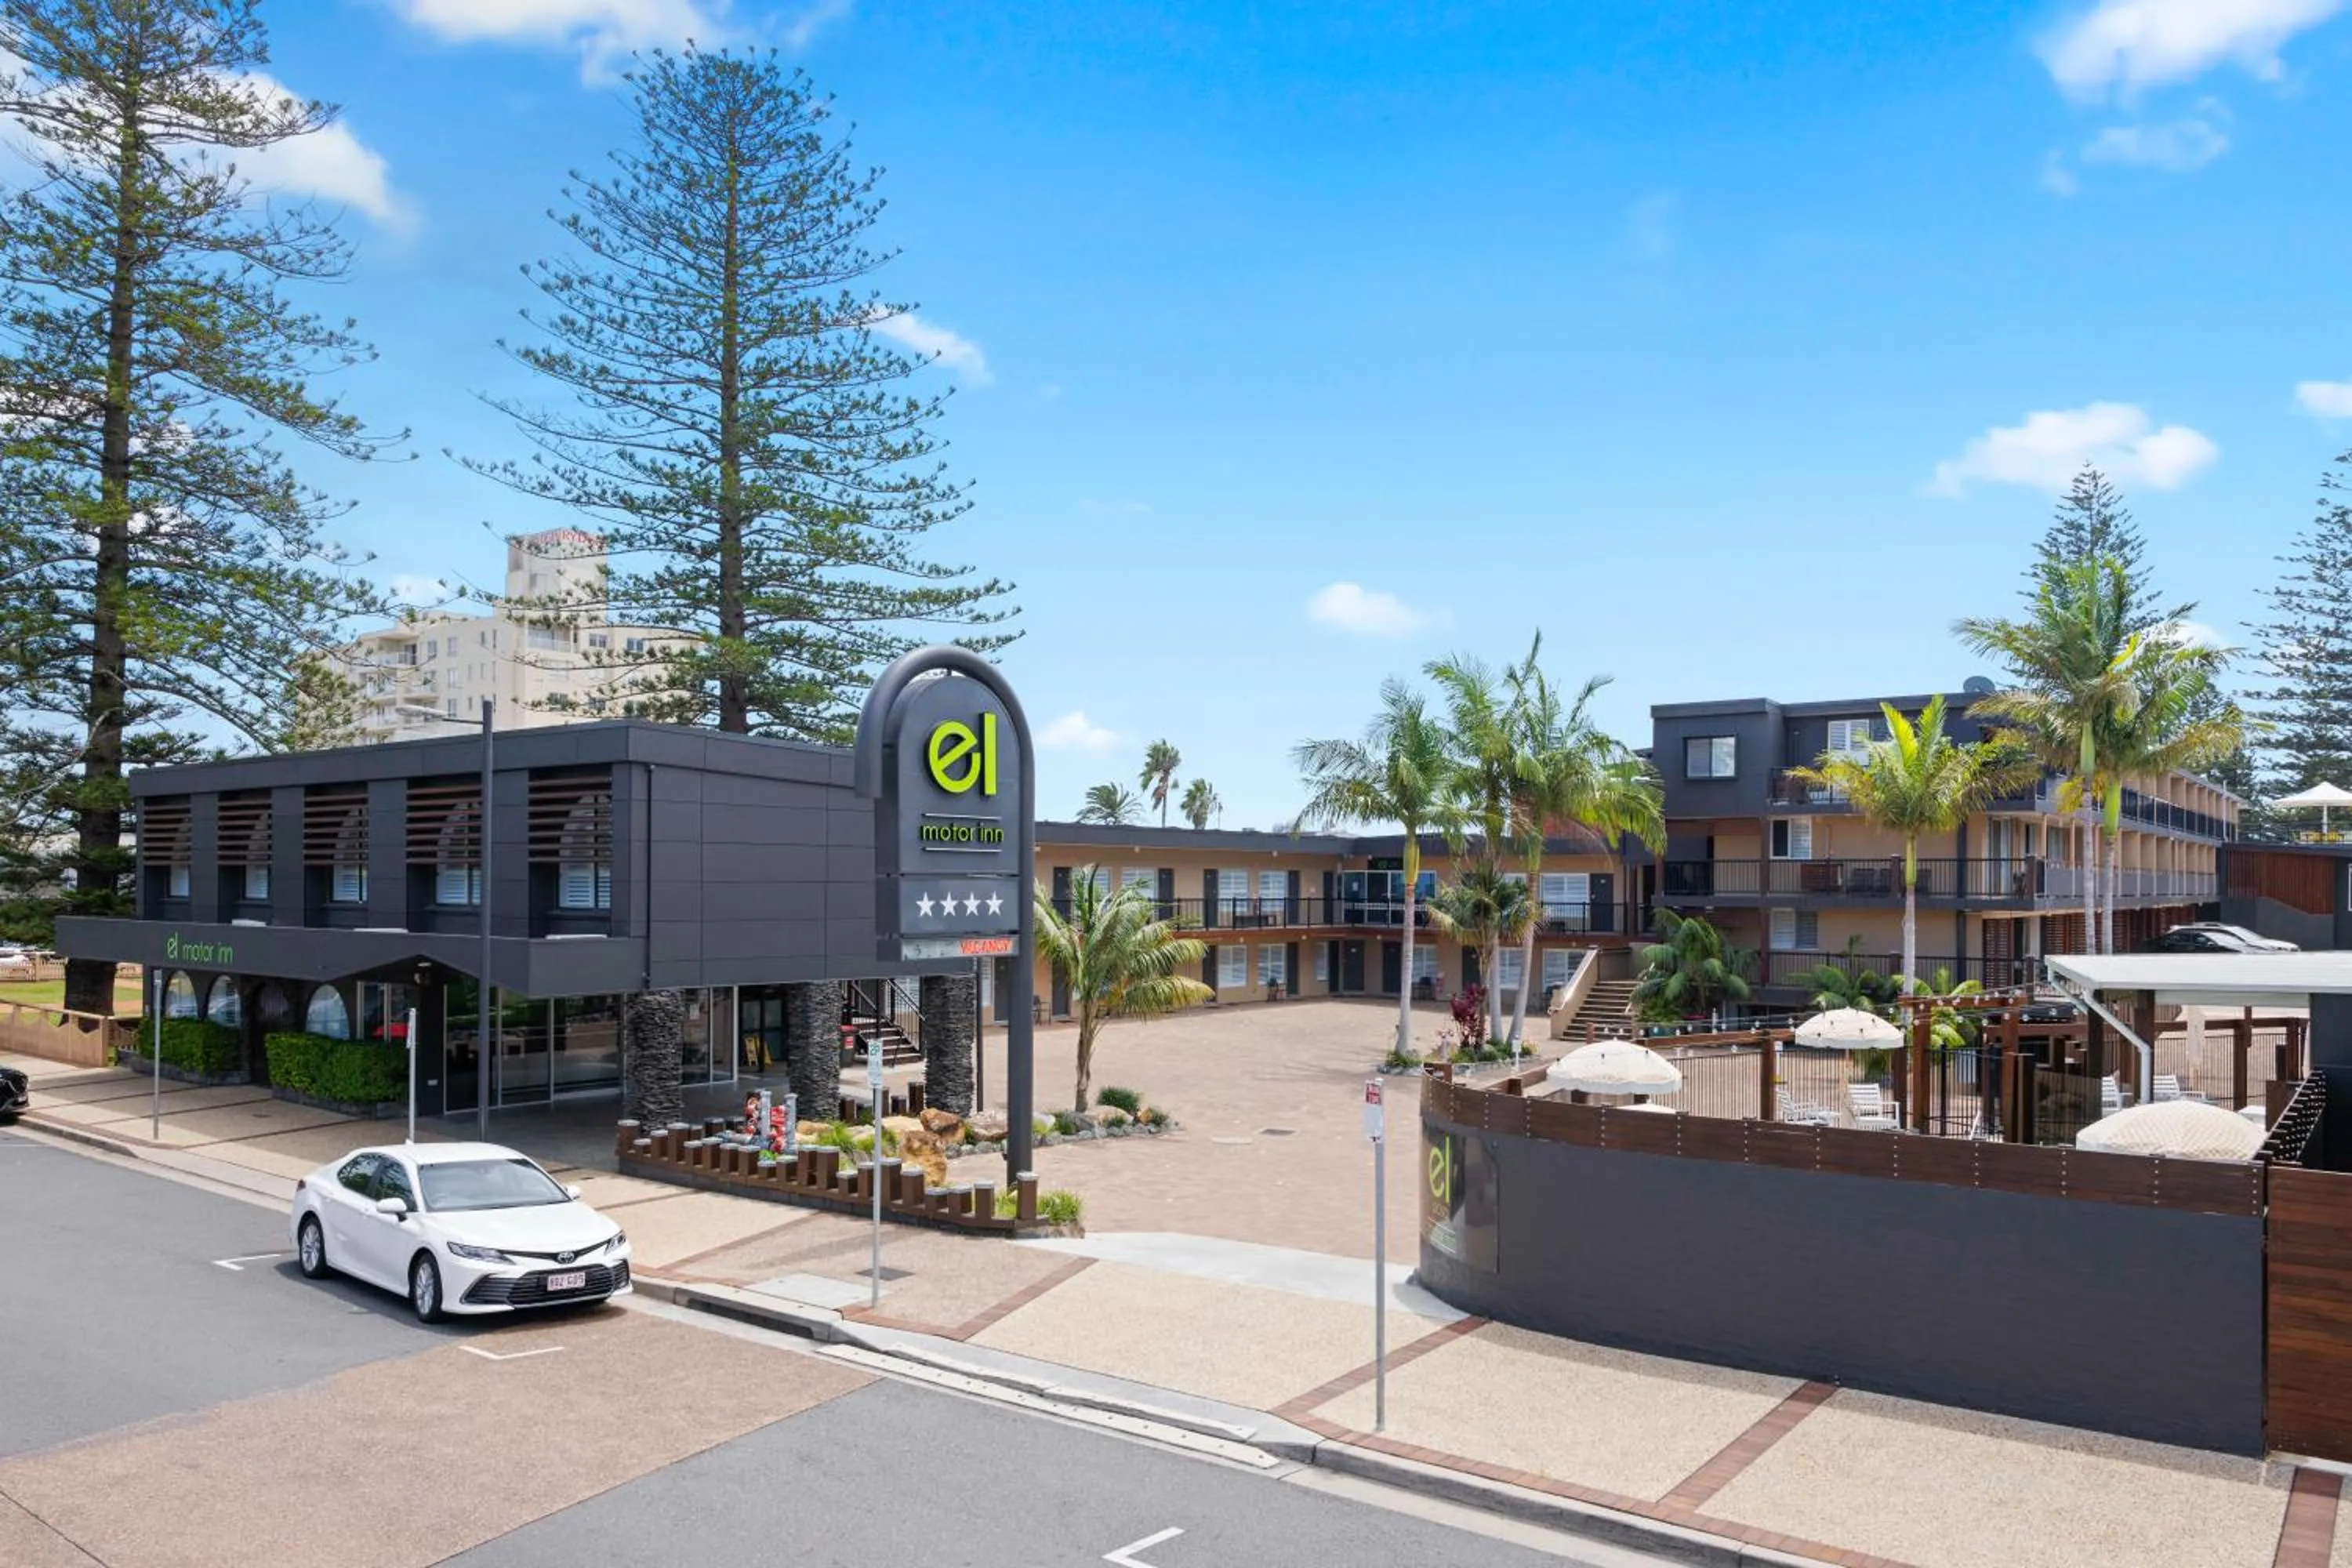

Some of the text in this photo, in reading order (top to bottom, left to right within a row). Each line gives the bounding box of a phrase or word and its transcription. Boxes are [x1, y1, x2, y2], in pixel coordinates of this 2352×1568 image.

[928, 711, 997, 797] el
[923, 822, 1004, 843] motor inn
[167, 931, 234, 964] el motor inn
[1429, 1136, 1450, 1204] el
